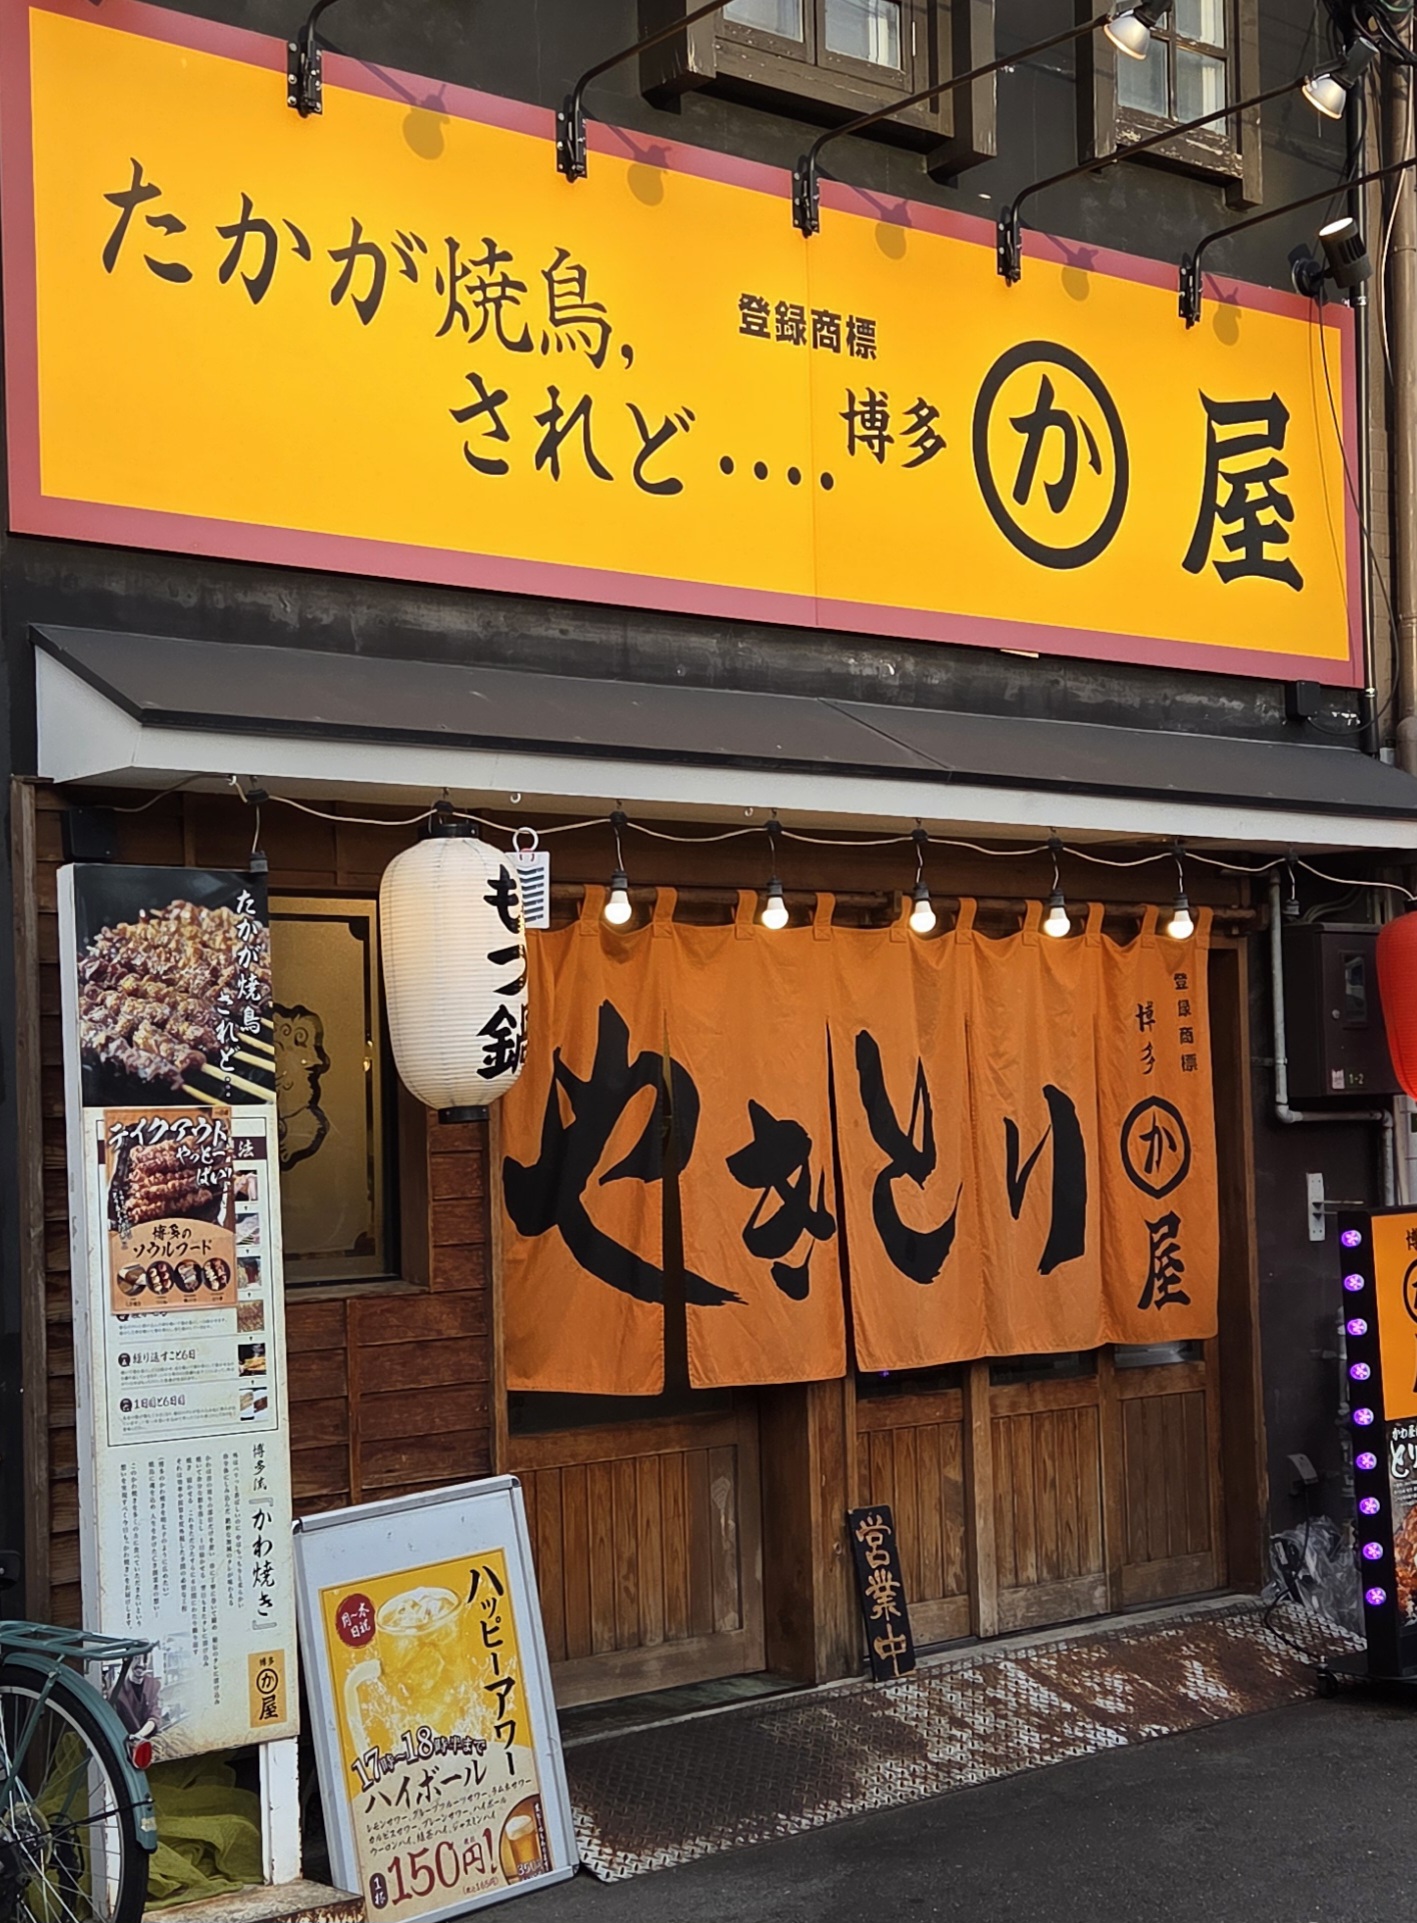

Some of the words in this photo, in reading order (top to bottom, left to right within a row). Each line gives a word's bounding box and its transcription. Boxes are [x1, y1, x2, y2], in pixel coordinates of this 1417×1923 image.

[737, 292, 878, 361] 登録商標
[838, 386, 947, 469] 博多
[236, 889, 262, 1035] たかが焼鳥
[1173, 972, 1198, 1073] 登録商標
[108, 1116, 227, 1150] テイクアウト
[503, 998, 1088, 1306] やきとり
[133, 1239, 213, 1259] ソウルフード
[152, 1223, 192, 1241] 博多の
[855, 1514, 907, 1677] 営業中
[467, 1564, 518, 1777] ハッピーアワー
[364, 1758, 488, 1815] ハイボール
